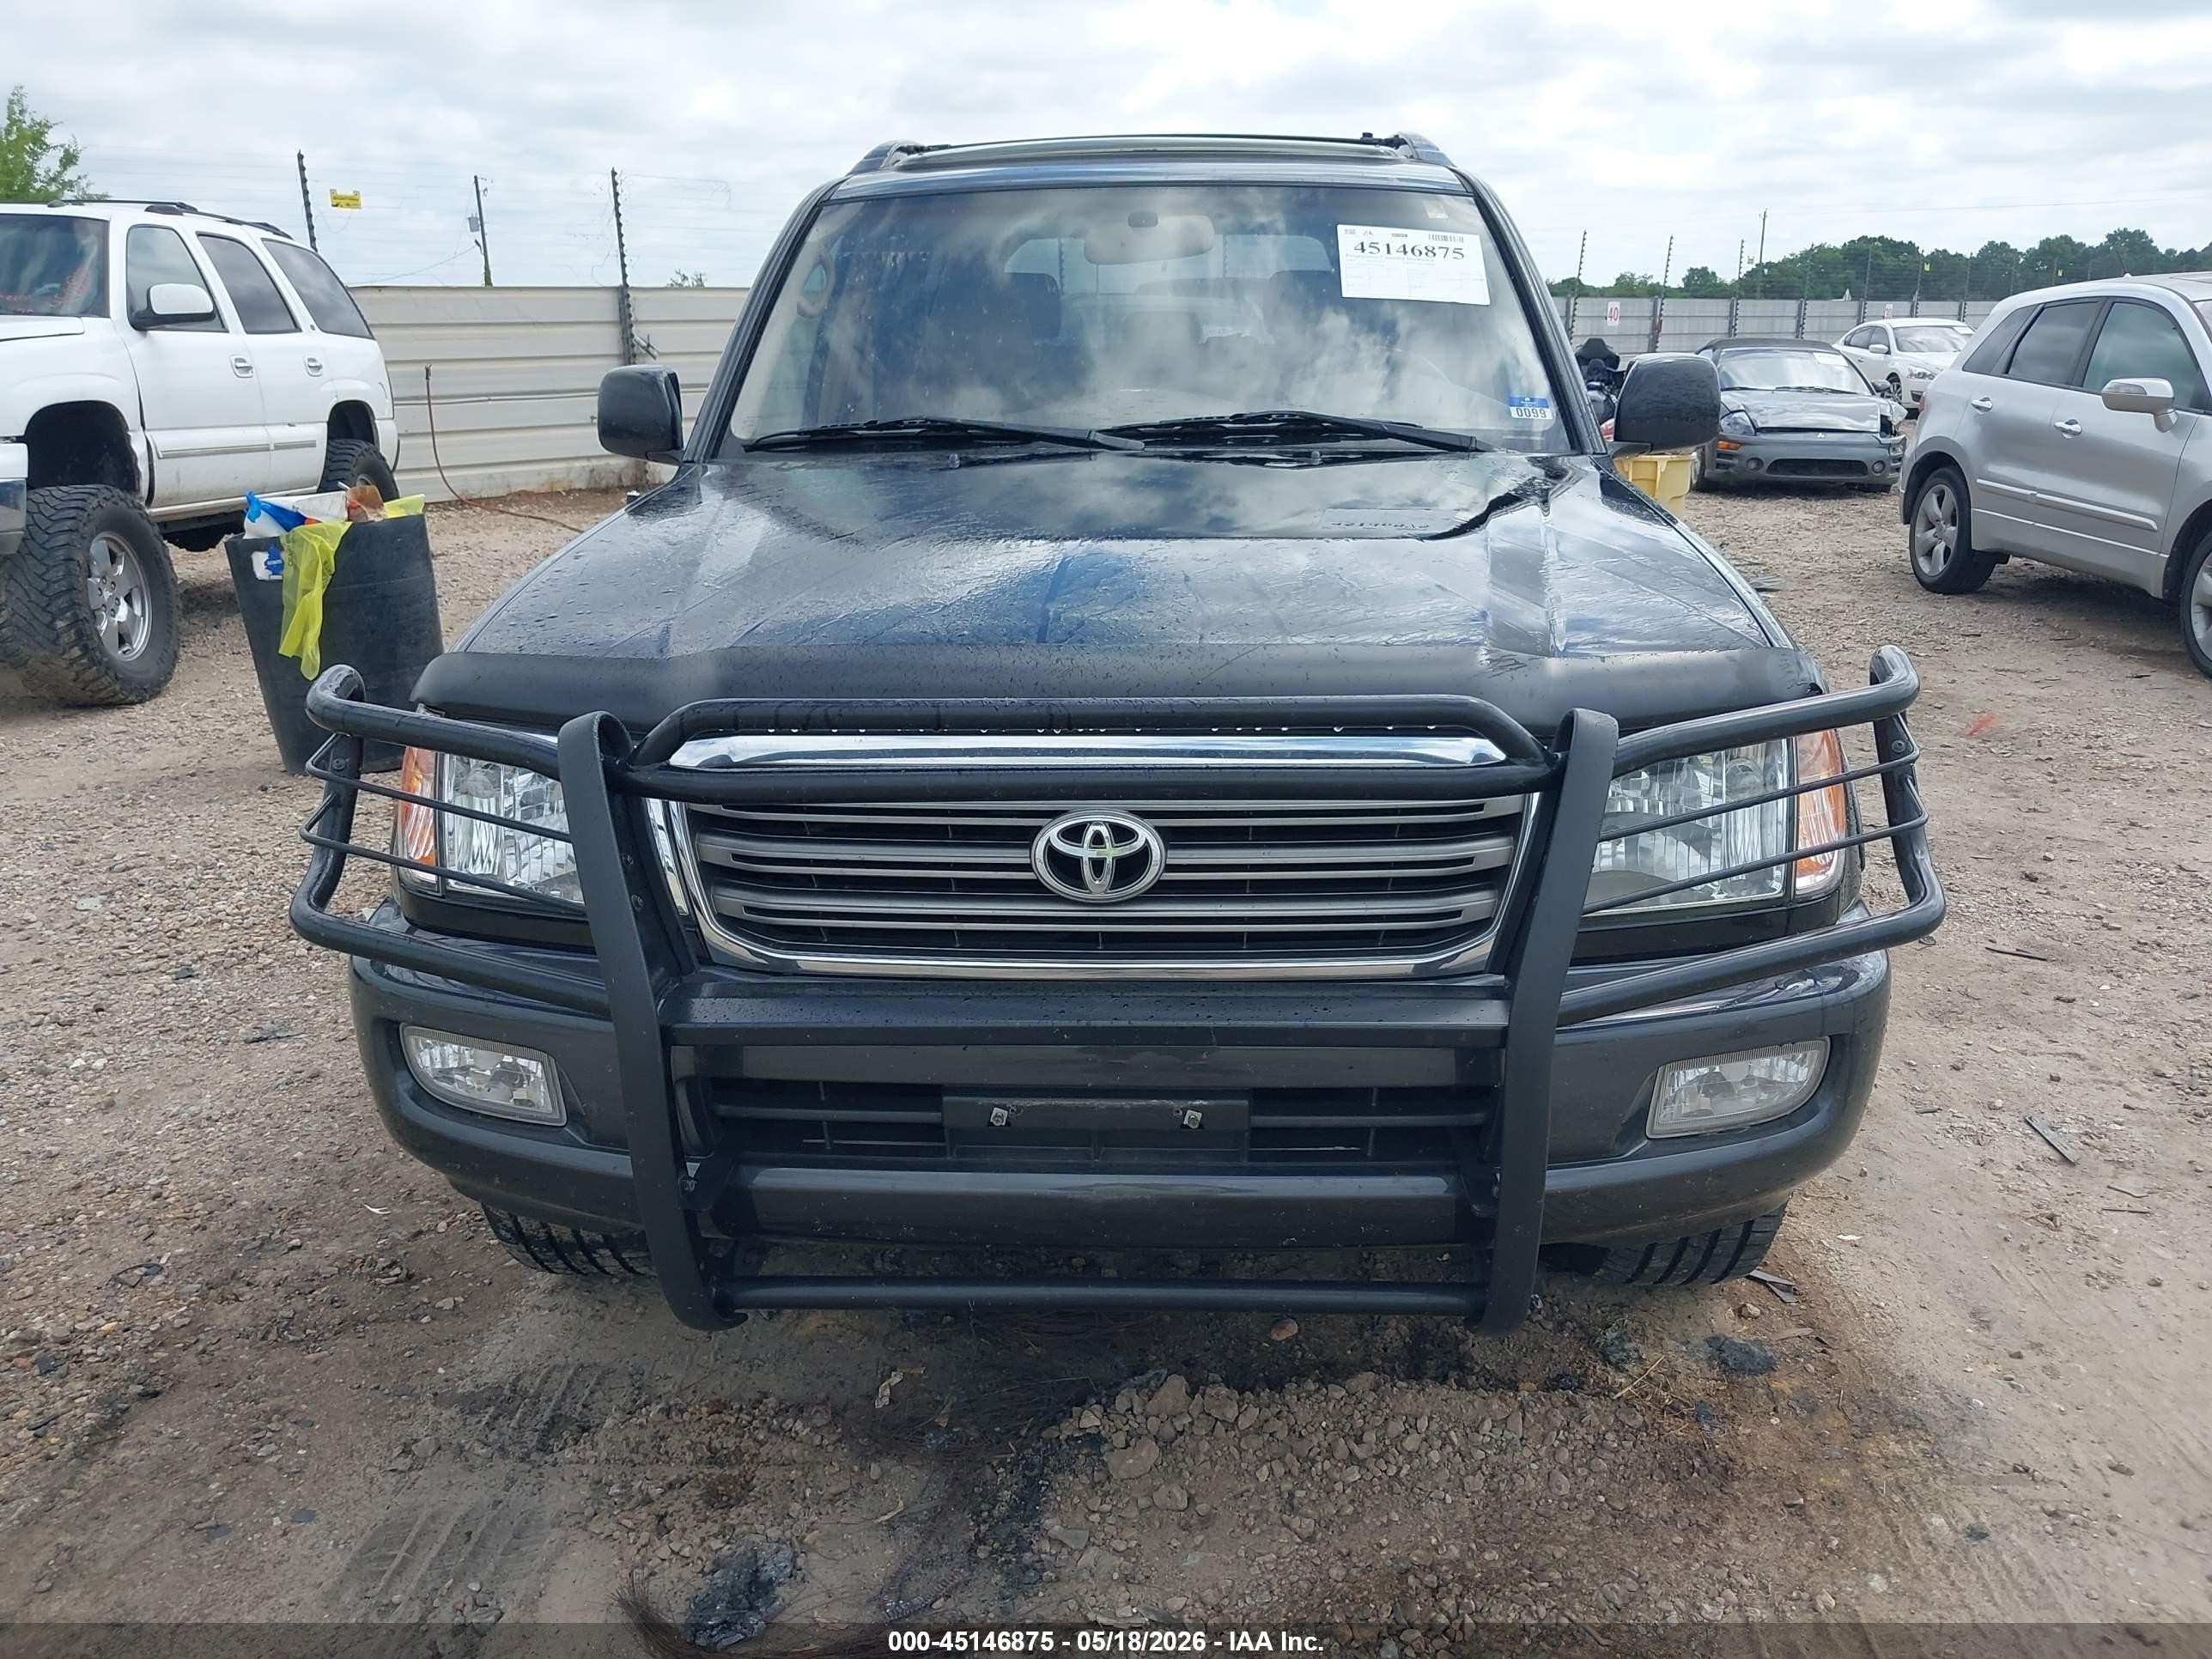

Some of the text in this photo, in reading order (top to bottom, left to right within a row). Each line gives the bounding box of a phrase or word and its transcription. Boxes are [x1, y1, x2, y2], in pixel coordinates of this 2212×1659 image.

[1354, 241, 1465, 259] 45146875
[1607, 307, 1619, 321] 40
[1516, 408, 1547, 418] 0099
